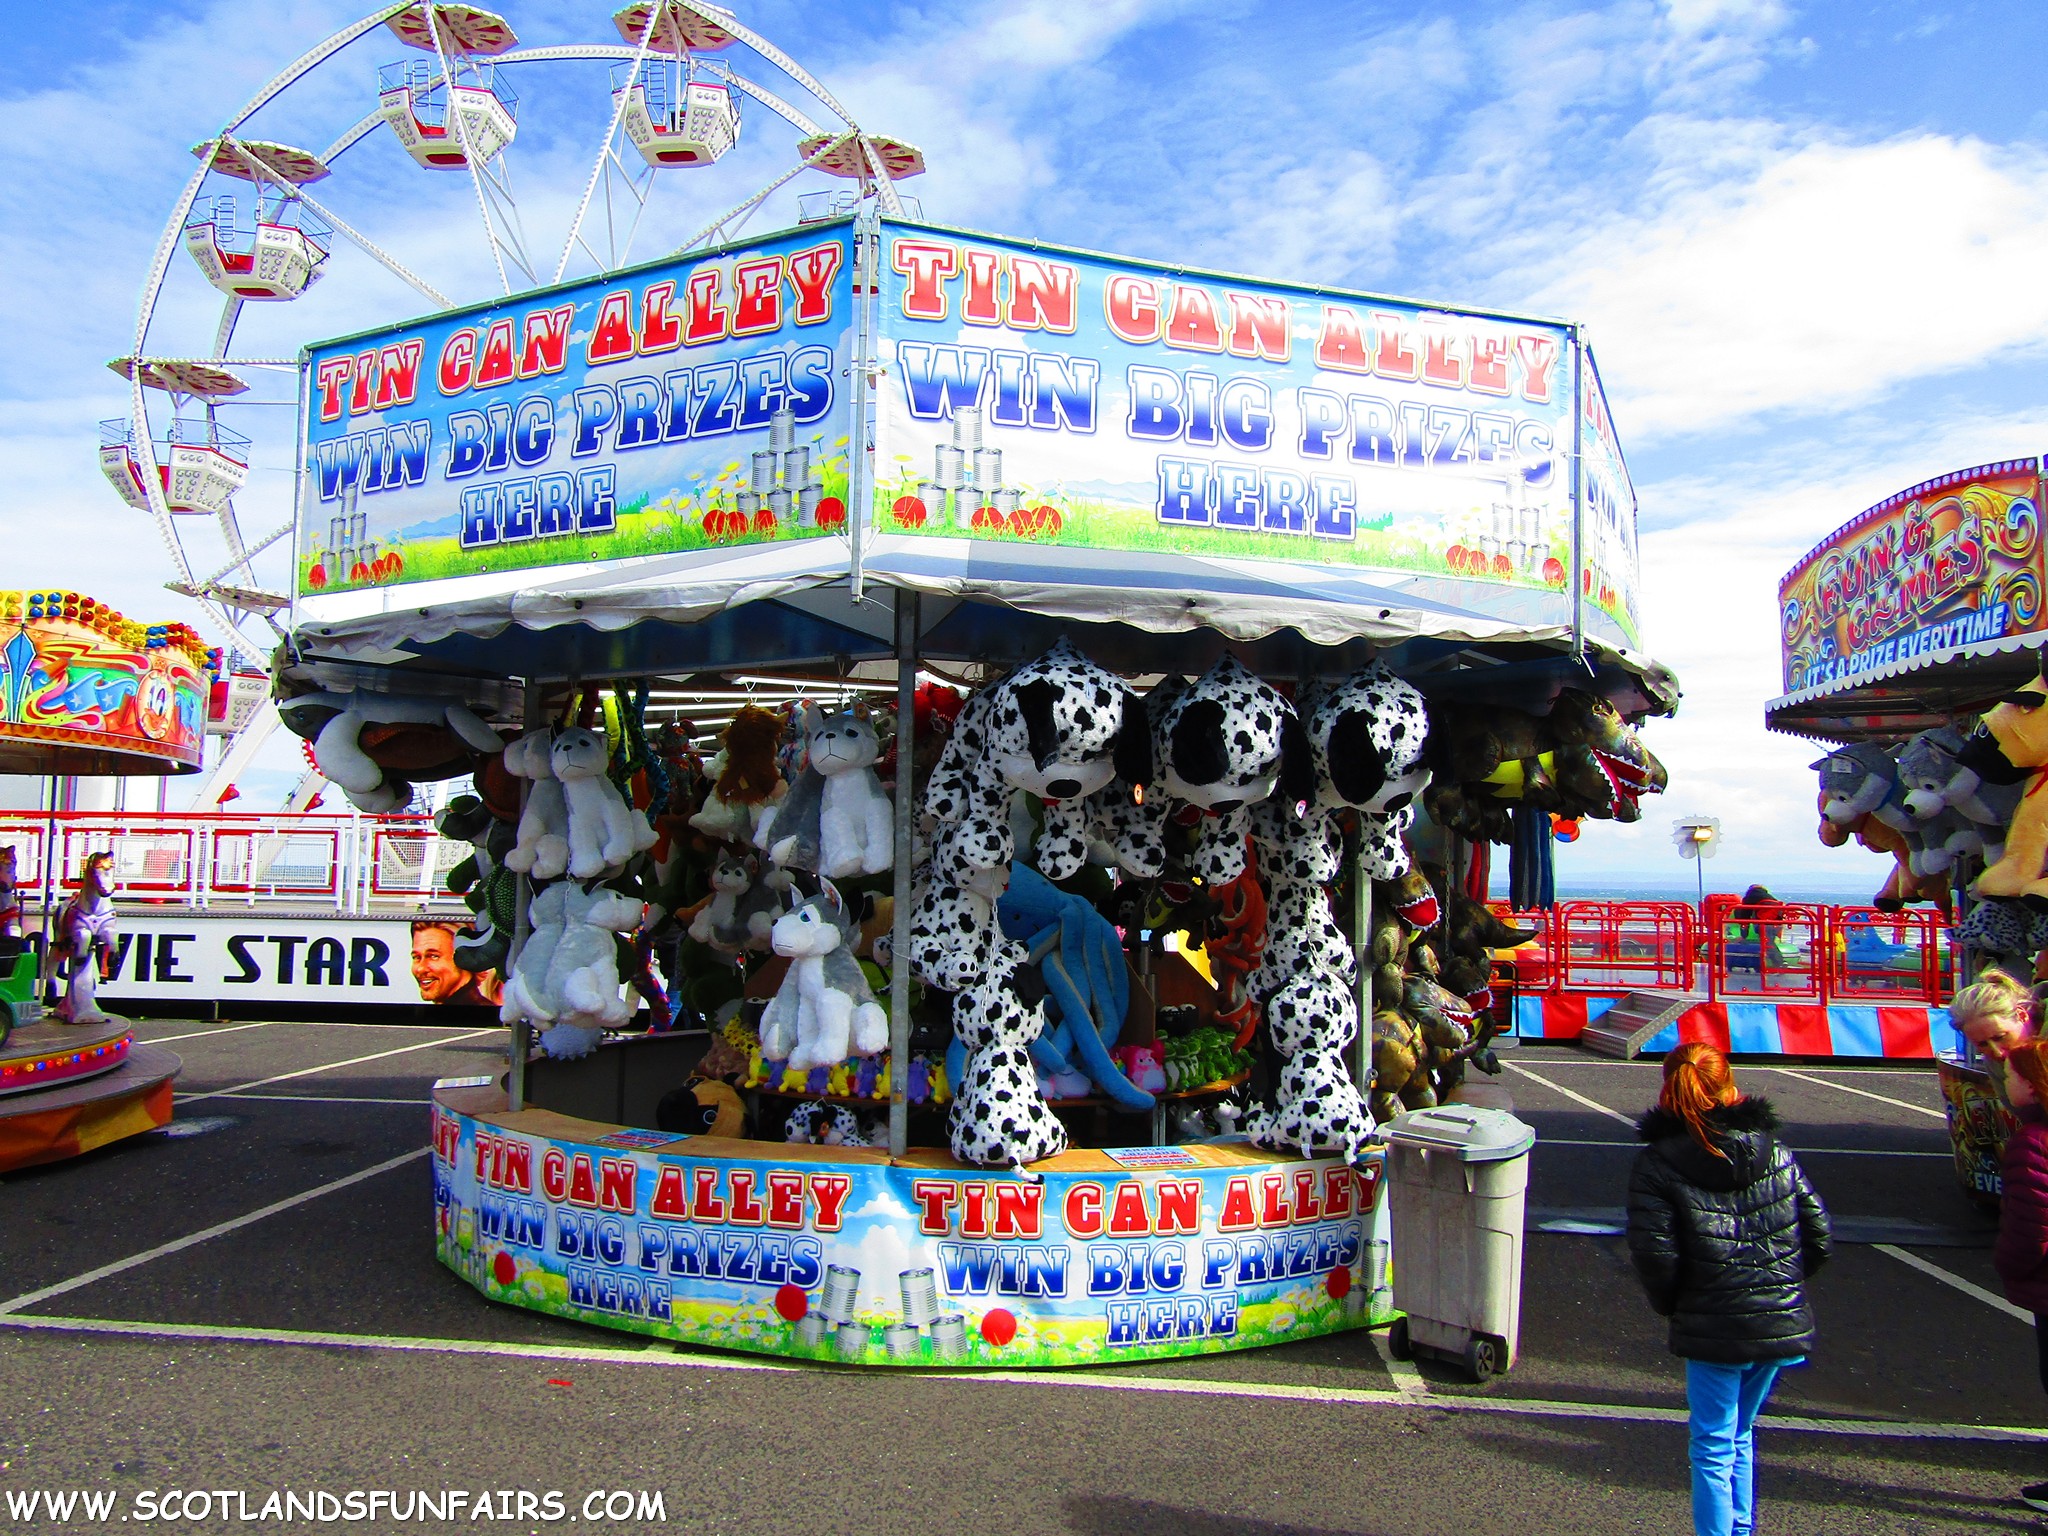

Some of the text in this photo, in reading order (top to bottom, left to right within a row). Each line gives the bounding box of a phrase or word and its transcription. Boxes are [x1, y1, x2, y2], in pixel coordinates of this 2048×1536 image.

[317, 242, 843, 421] TIN CAN ALLEY
[892, 239, 1560, 404] TIN CAN ALLEY
[317, 345, 836, 500] WIN BIG PRIZES
[899, 341, 1099, 433] WIN
[1127, 364, 1275, 450] BIG
[1298, 386, 1556, 488] PRIZES
[460, 465, 616, 548] HERE
[1157, 456, 1356, 542] HERE
[1817, 499, 1932, 627] FUN &
[1847, 514, 1983, 651] GAMES
[1805, 661, 1834, 690] IT'S
[1836, 657, 1848, 679] A
[1850, 643, 1895, 674] PRIZE
[223, 934, 391, 987] STAR
[474, 1130, 534, 1195] TIN
[541, 1147, 638, 1216] CAN
[651, 1164, 852, 1232] ALLEY
[913, 1160, 1382, 1240] TIN CAN ALLEY
[479, 1188, 822, 1290] WIN BIG PRIZES
[938, 1219, 1363, 1297] WIN BIG PRIZES
[568, 1262, 673, 1324] HERE
[1105, 1290, 1239, 1346] HERE
